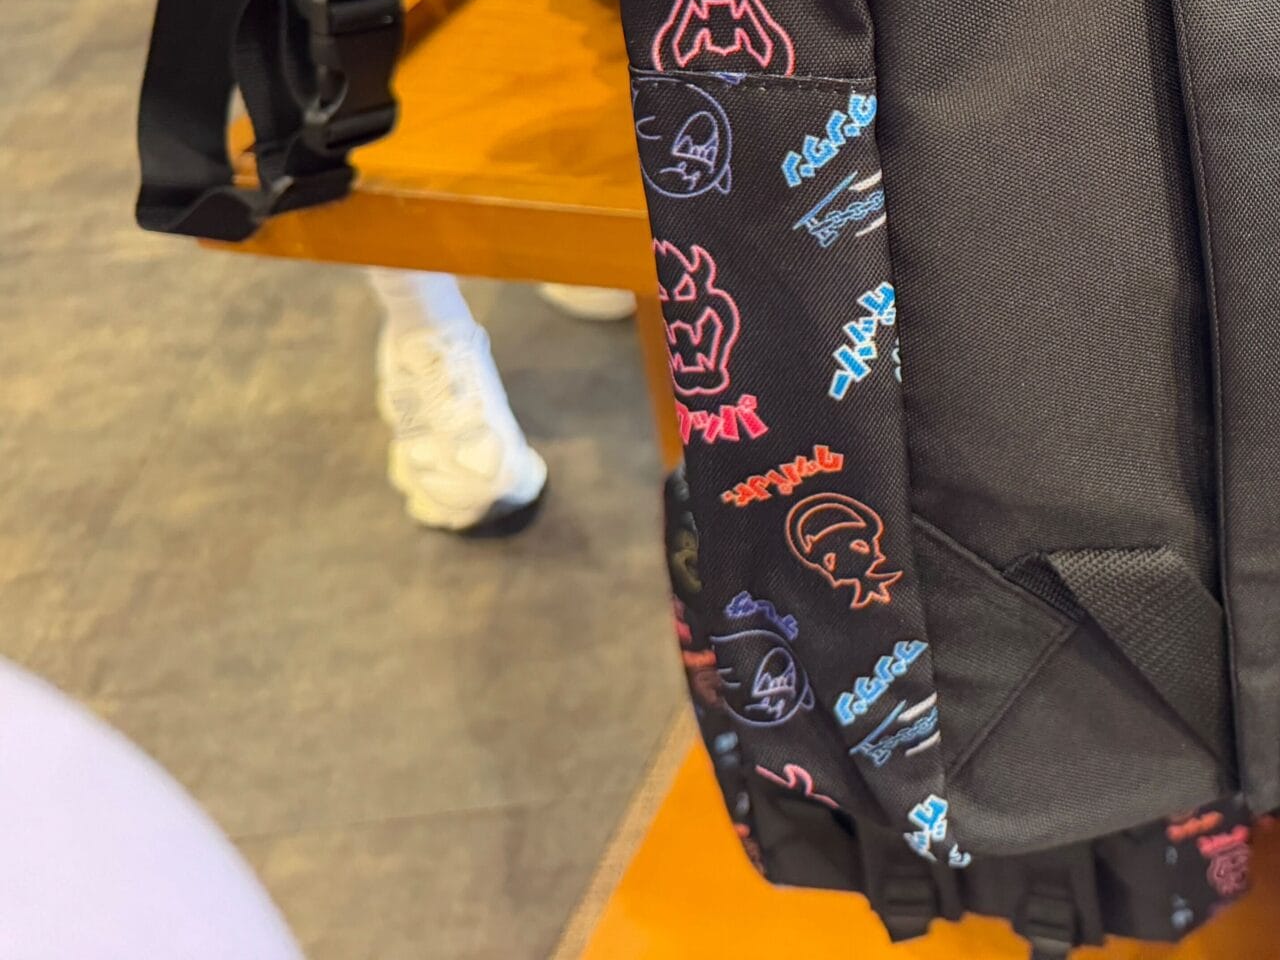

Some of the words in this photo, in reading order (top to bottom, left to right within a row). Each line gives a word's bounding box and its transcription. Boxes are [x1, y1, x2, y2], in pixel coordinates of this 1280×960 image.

[781, 93, 878, 188] ワンワン
[834, 639, 929, 727] ワンワン
